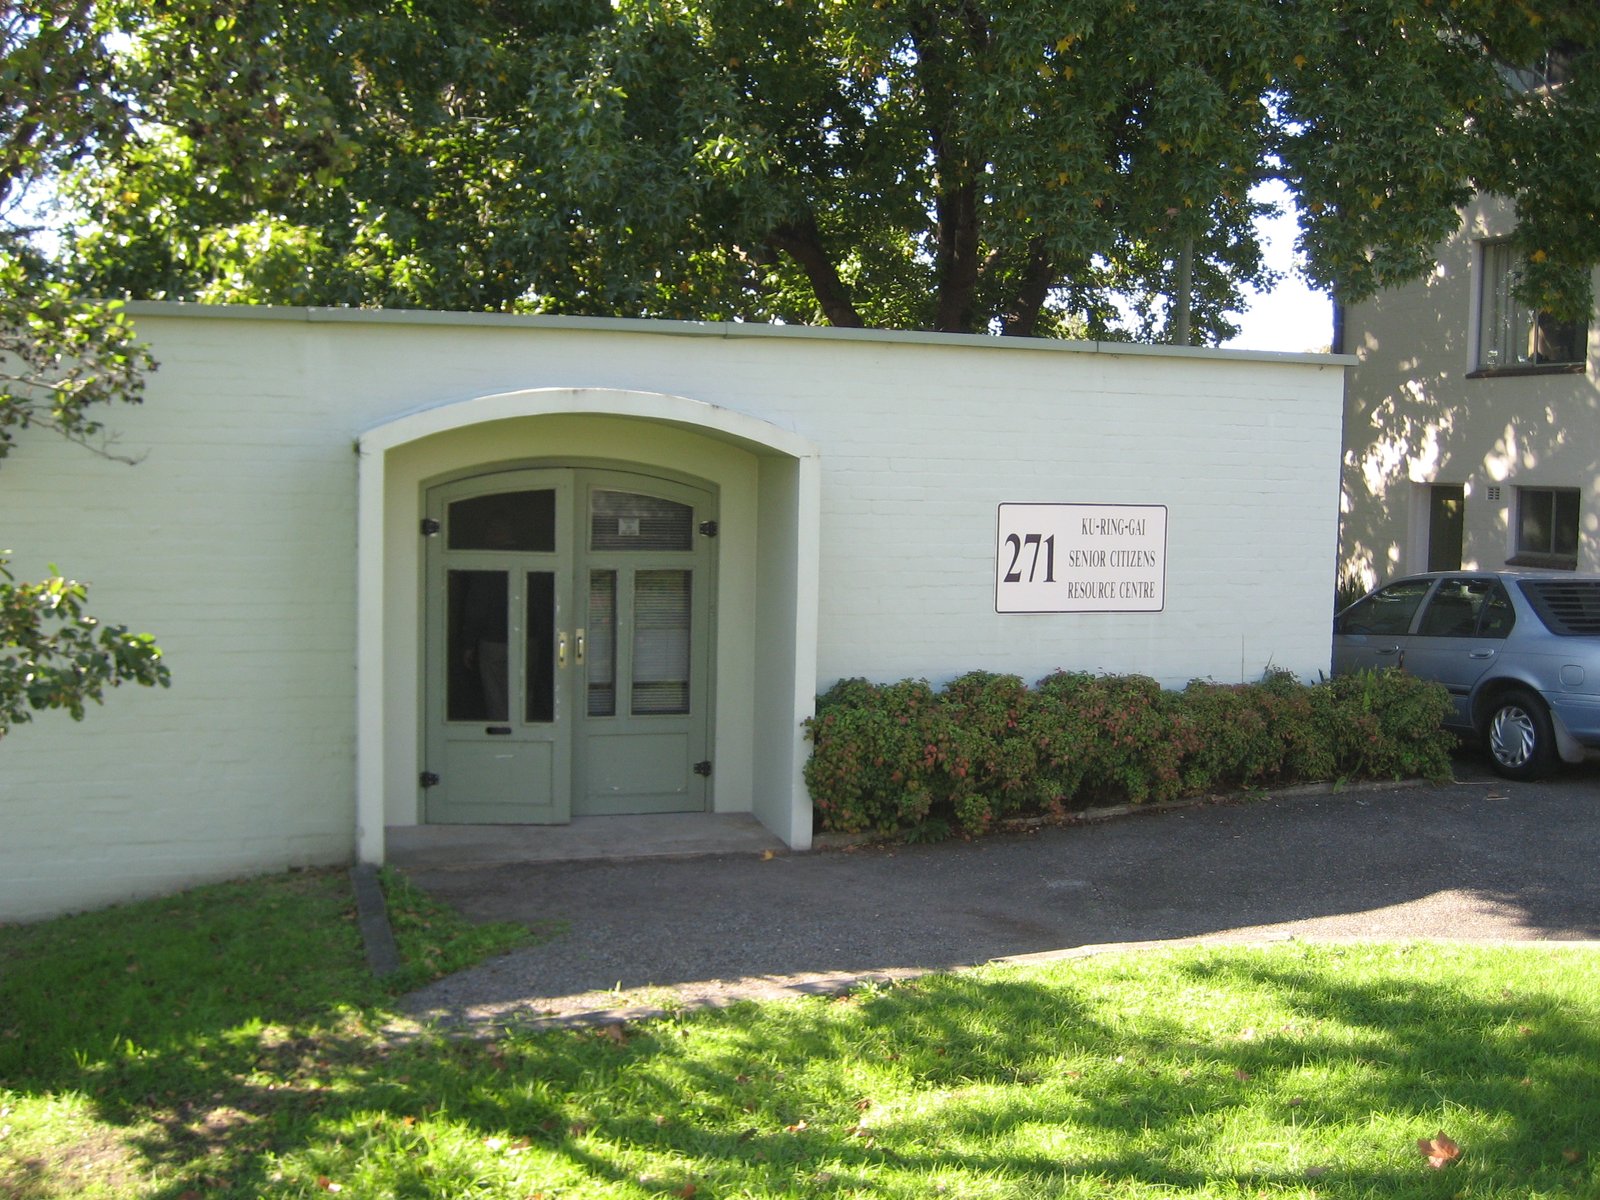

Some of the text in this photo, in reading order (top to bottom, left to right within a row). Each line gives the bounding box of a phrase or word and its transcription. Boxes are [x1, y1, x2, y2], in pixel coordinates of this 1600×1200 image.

[1081, 518, 1146, 536] KU-RING-GAI
[1003, 533, 1057, 583] 271
[1068, 550, 1156, 568] SENIOR CITIZENS
[1067, 581, 1155, 599] RESOURCE CENTRE
